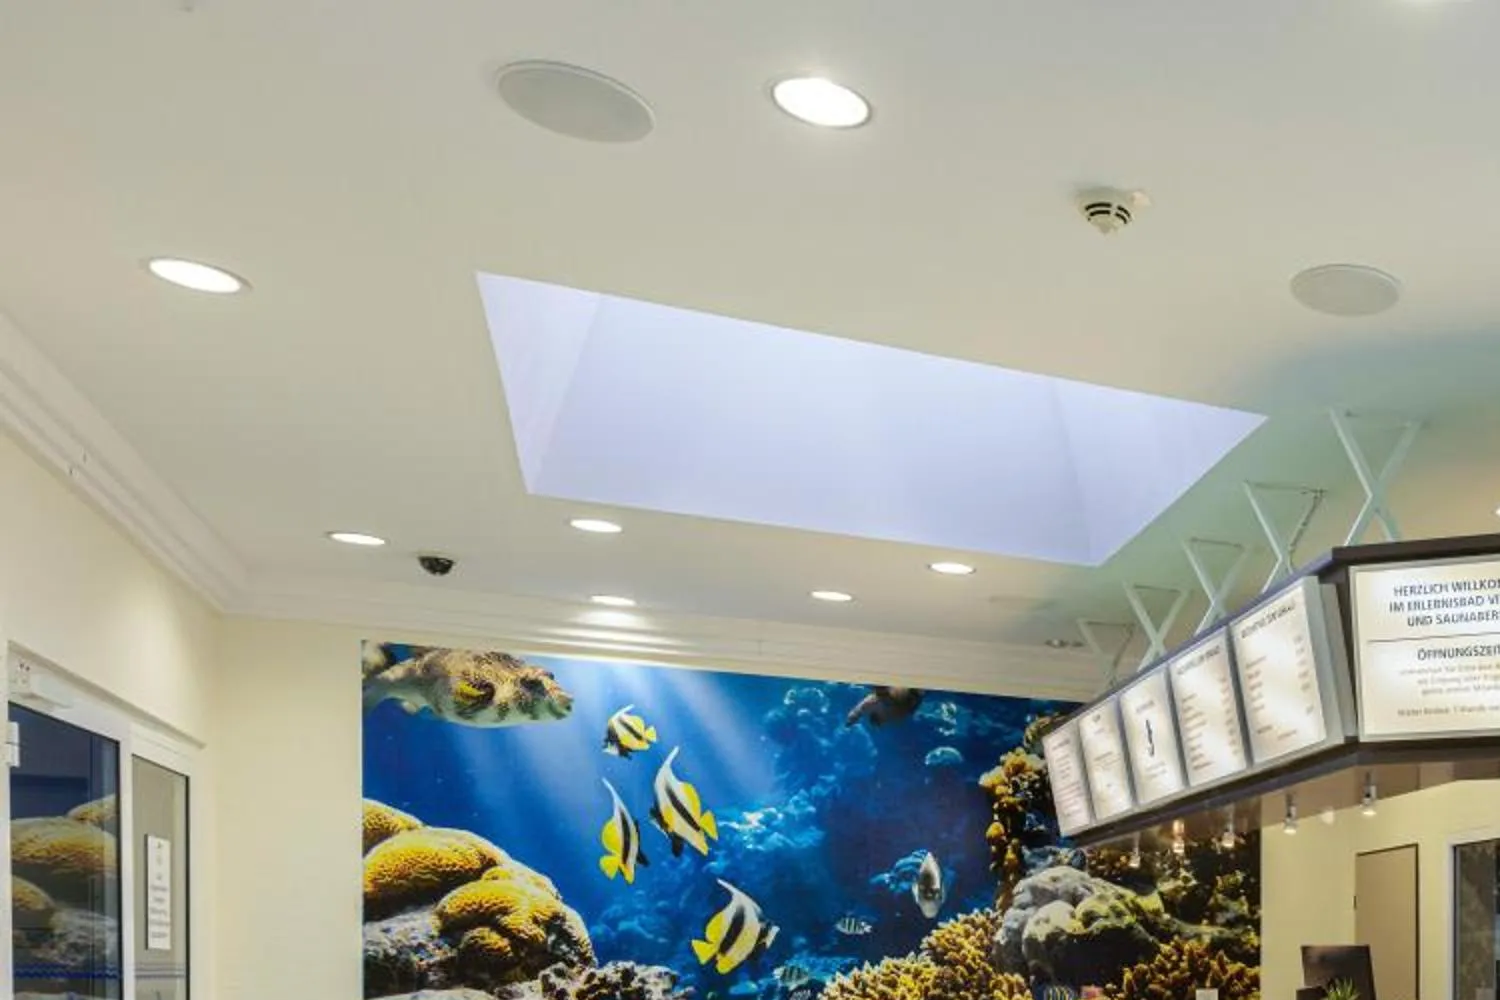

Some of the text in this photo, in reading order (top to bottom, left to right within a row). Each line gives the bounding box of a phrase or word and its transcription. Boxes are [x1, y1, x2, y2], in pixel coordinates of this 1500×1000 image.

[1394, 583, 1448, 597] HERZLICH
[1389, 602, 1404, 613] IM
[1407, 595, 1485, 612] ERLEBNISBAD
[1407, 616, 1433, 627] UND
